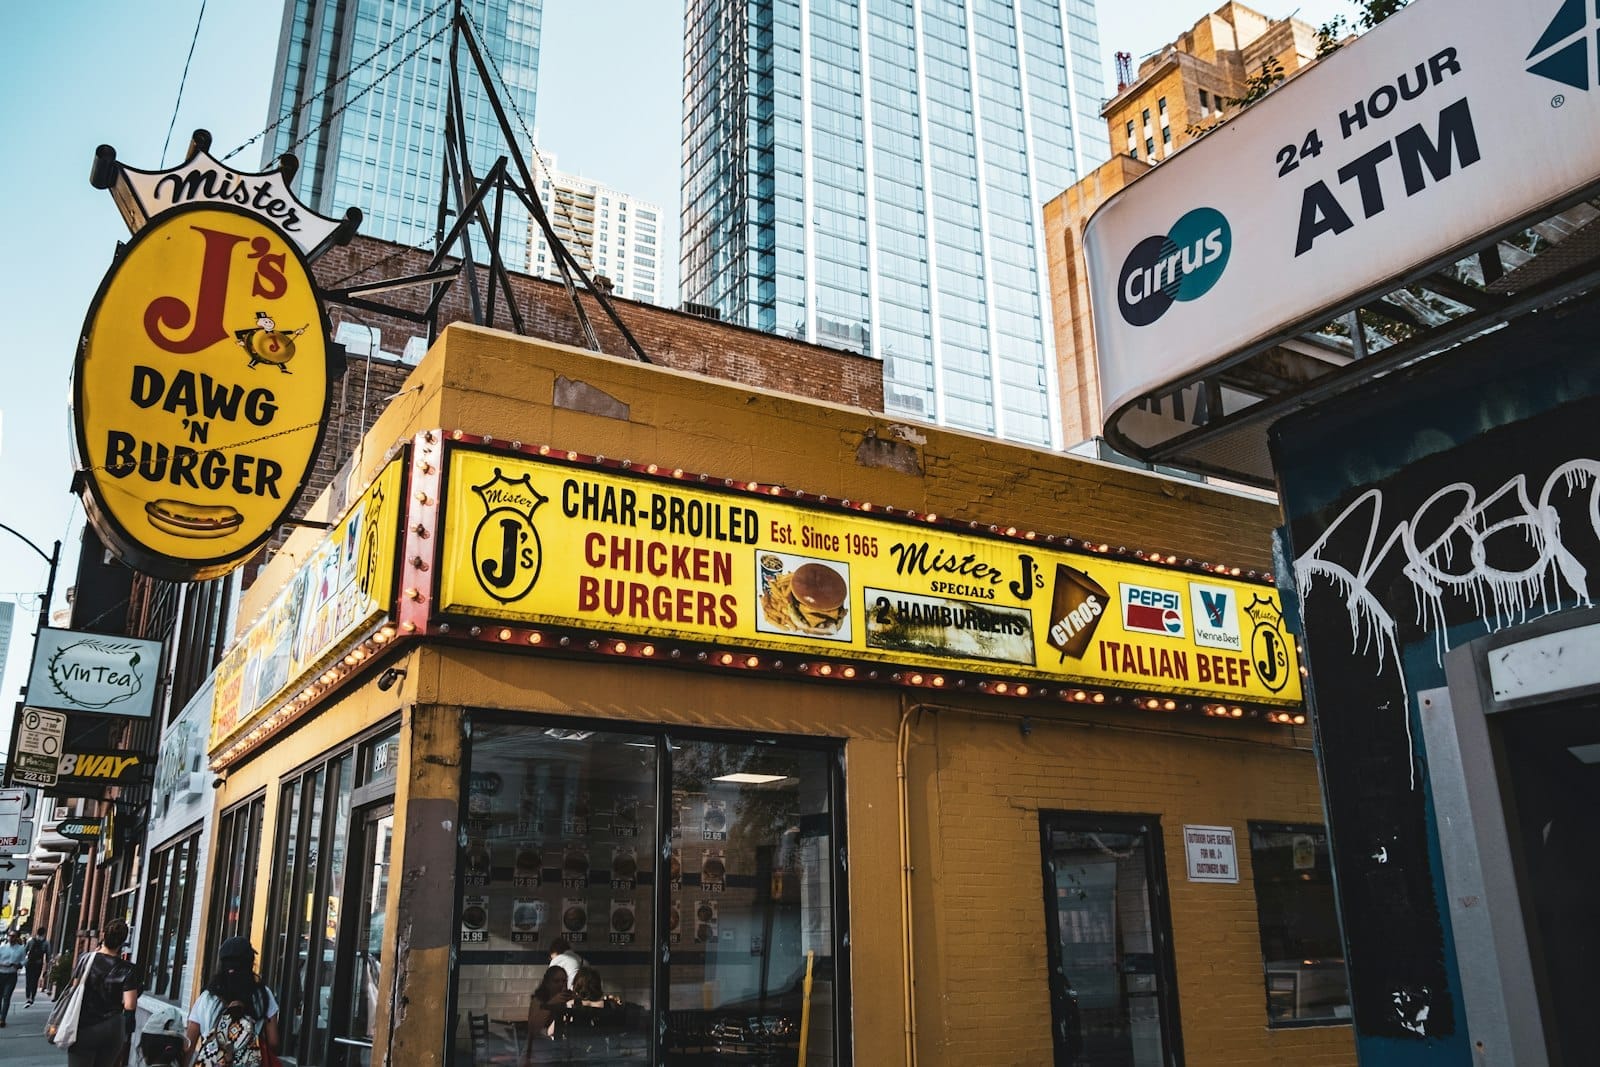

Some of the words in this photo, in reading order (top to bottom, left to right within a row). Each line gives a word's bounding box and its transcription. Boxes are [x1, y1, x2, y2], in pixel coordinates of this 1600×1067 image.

[1276, 128, 1323, 178] 24
[1339, 46, 1462, 140] HOUR
[1293, 96, 1481, 259] ATM
[143, 225, 288, 354] J's
[130, 365, 278, 427] DAWG
[182, 418, 208, 445] 'N
[104, 430, 283, 500] BURGER
[485, 489, 533, 508] Mister
[562, 479, 759, 545] CHAR-BROILED
[481, 518, 534, 588] J's
[585, 532, 733, 586] CHICKEN
[770, 520, 797, 546] Est.
[801, 526, 840, 553] Since
[844, 532, 879, 559] 1965
[890, 542, 1003, 585] Mister
[1009, 553, 1045, 601] J's
[930, 580, 995, 600] SPECIALS
[578, 575, 738, 629] BURGERS
[875, 596, 891, 625] 2
[897, 600, 1025, 636] HAMBURGERS
[1050, 593, 1102, 648] GYROS
[1128, 588, 1179, 610] PEPSI
[1250, 608, 1277, 622] Mister
[1099, 640, 1189, 682] ITALIAN
[1196, 653, 1251, 689] BEEF
[1258, 630, 1285, 682] J's
[61, 824, 101, 835] SUBWA
